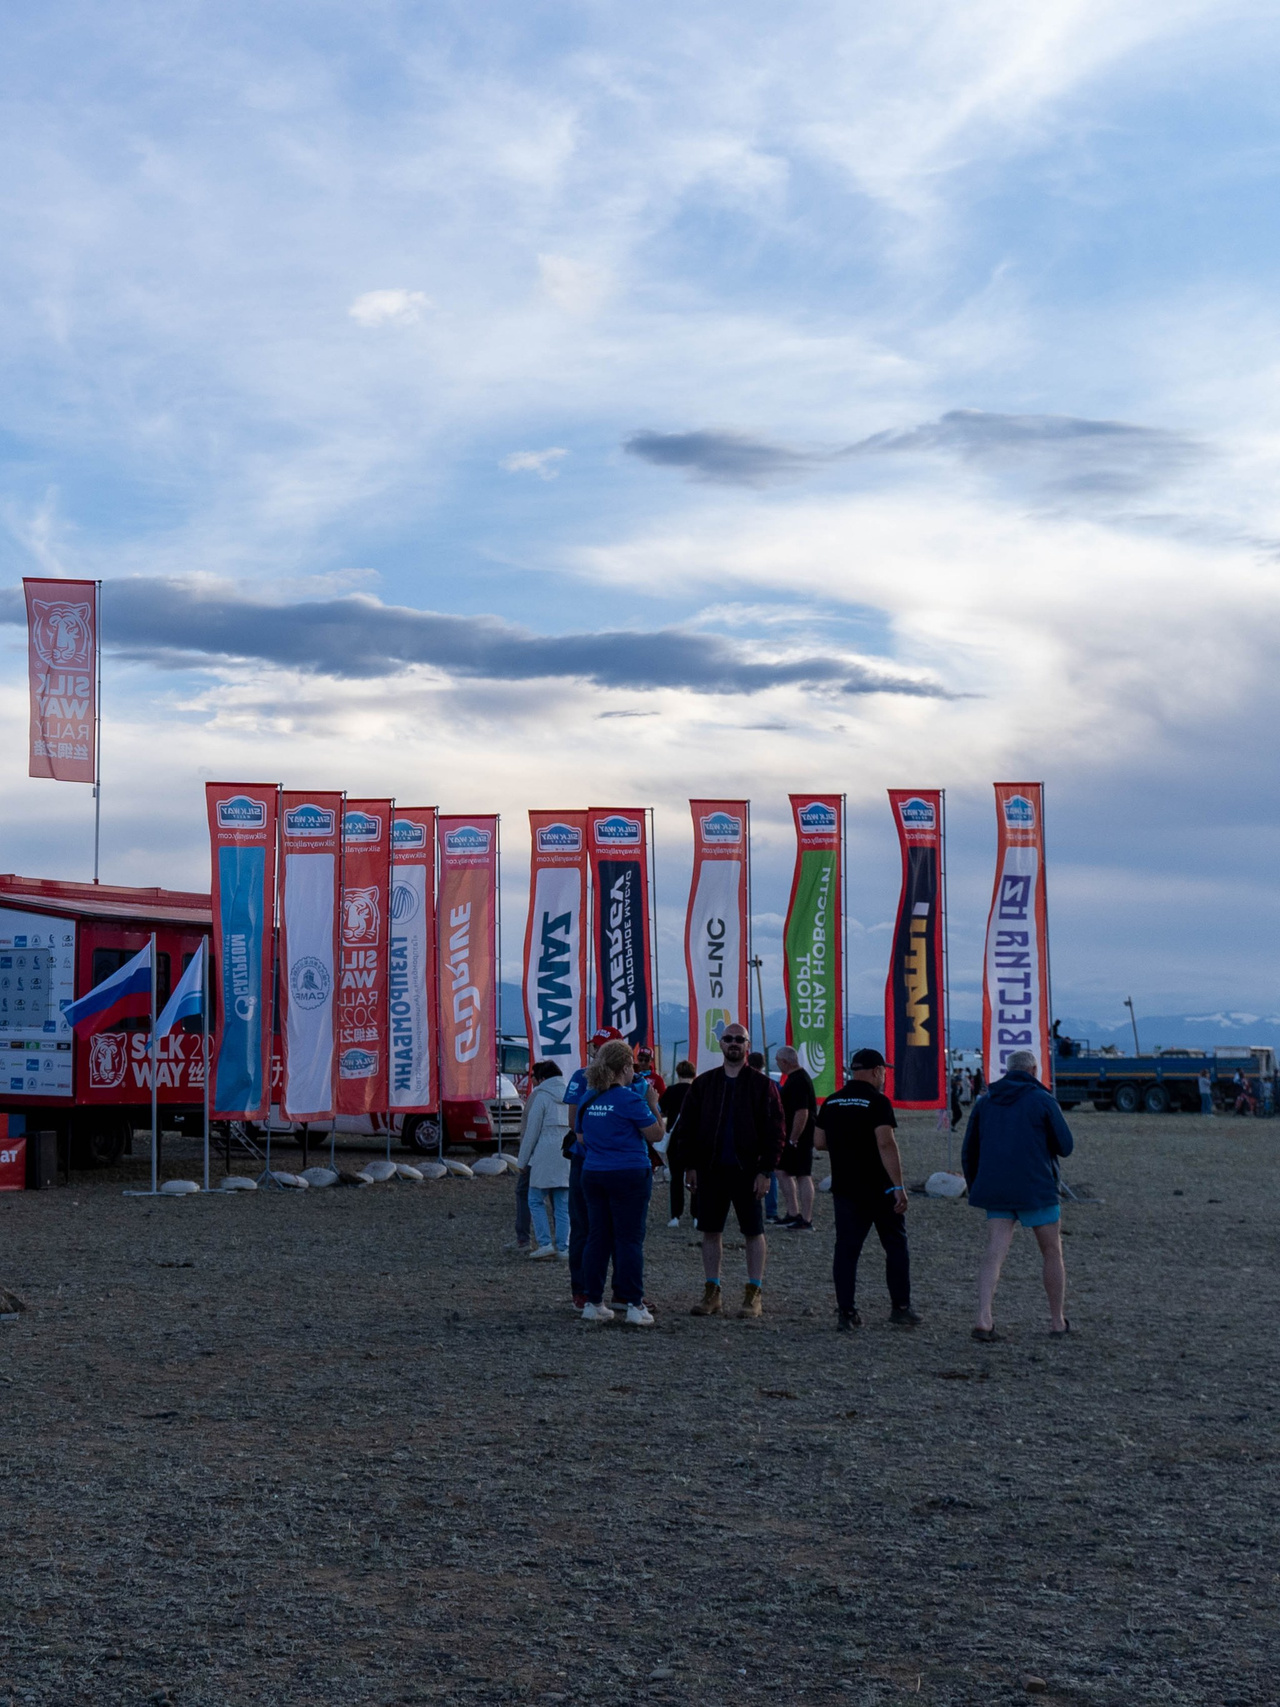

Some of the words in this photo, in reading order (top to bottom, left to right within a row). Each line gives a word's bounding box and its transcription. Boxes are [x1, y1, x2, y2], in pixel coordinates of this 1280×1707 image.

[131, 1035, 186, 1060] SLK
[131, 1062, 186, 1088] WAY
[587, 1104, 614, 1112] AMAZ
